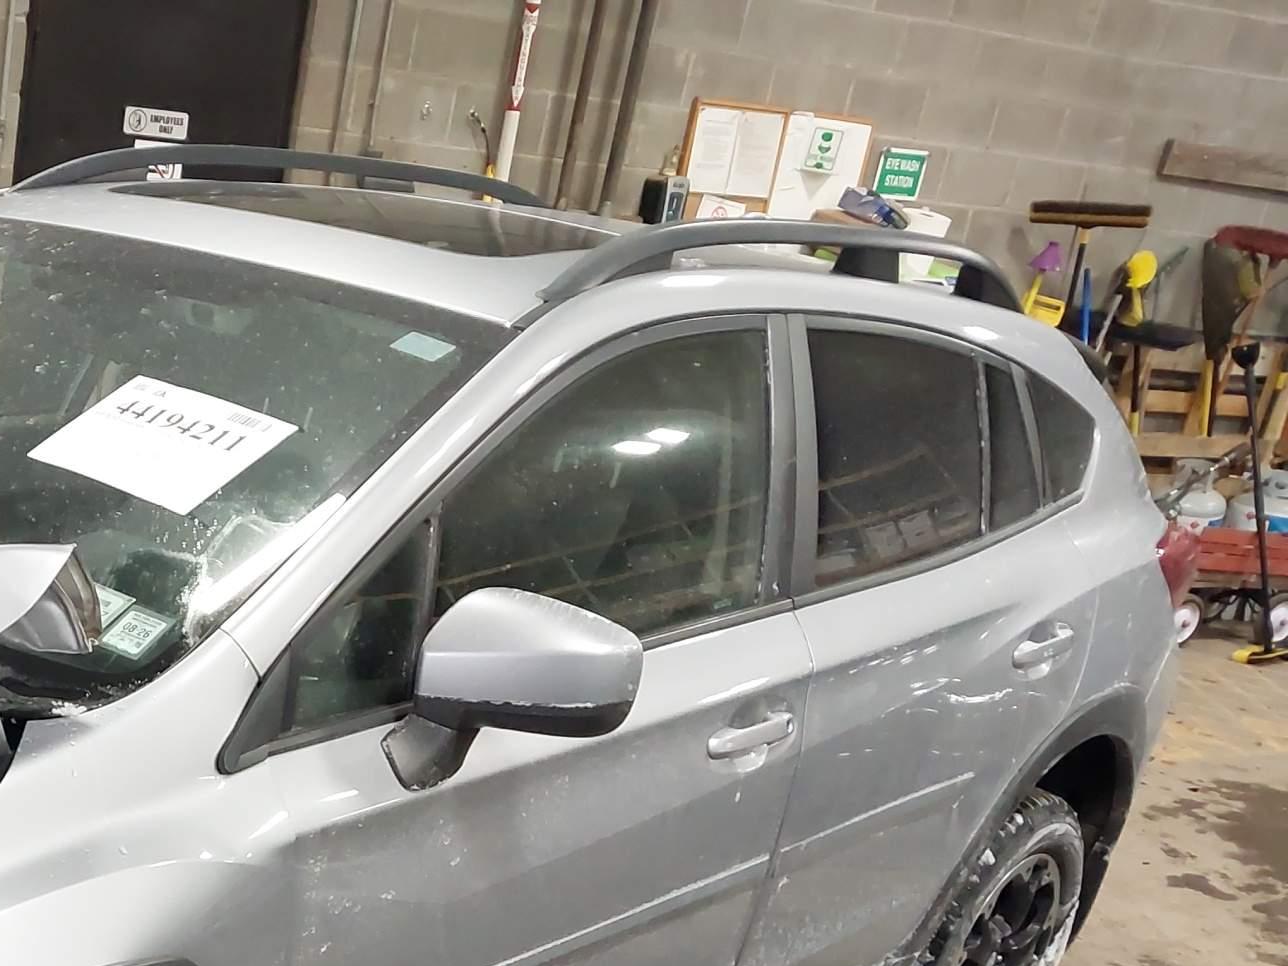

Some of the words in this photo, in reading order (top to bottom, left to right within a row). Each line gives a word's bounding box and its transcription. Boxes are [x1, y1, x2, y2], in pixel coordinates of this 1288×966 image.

[885, 158, 901, 170] EYE
[884, 175, 914, 188] STATION
[117, 400, 247, 451] 44194211
